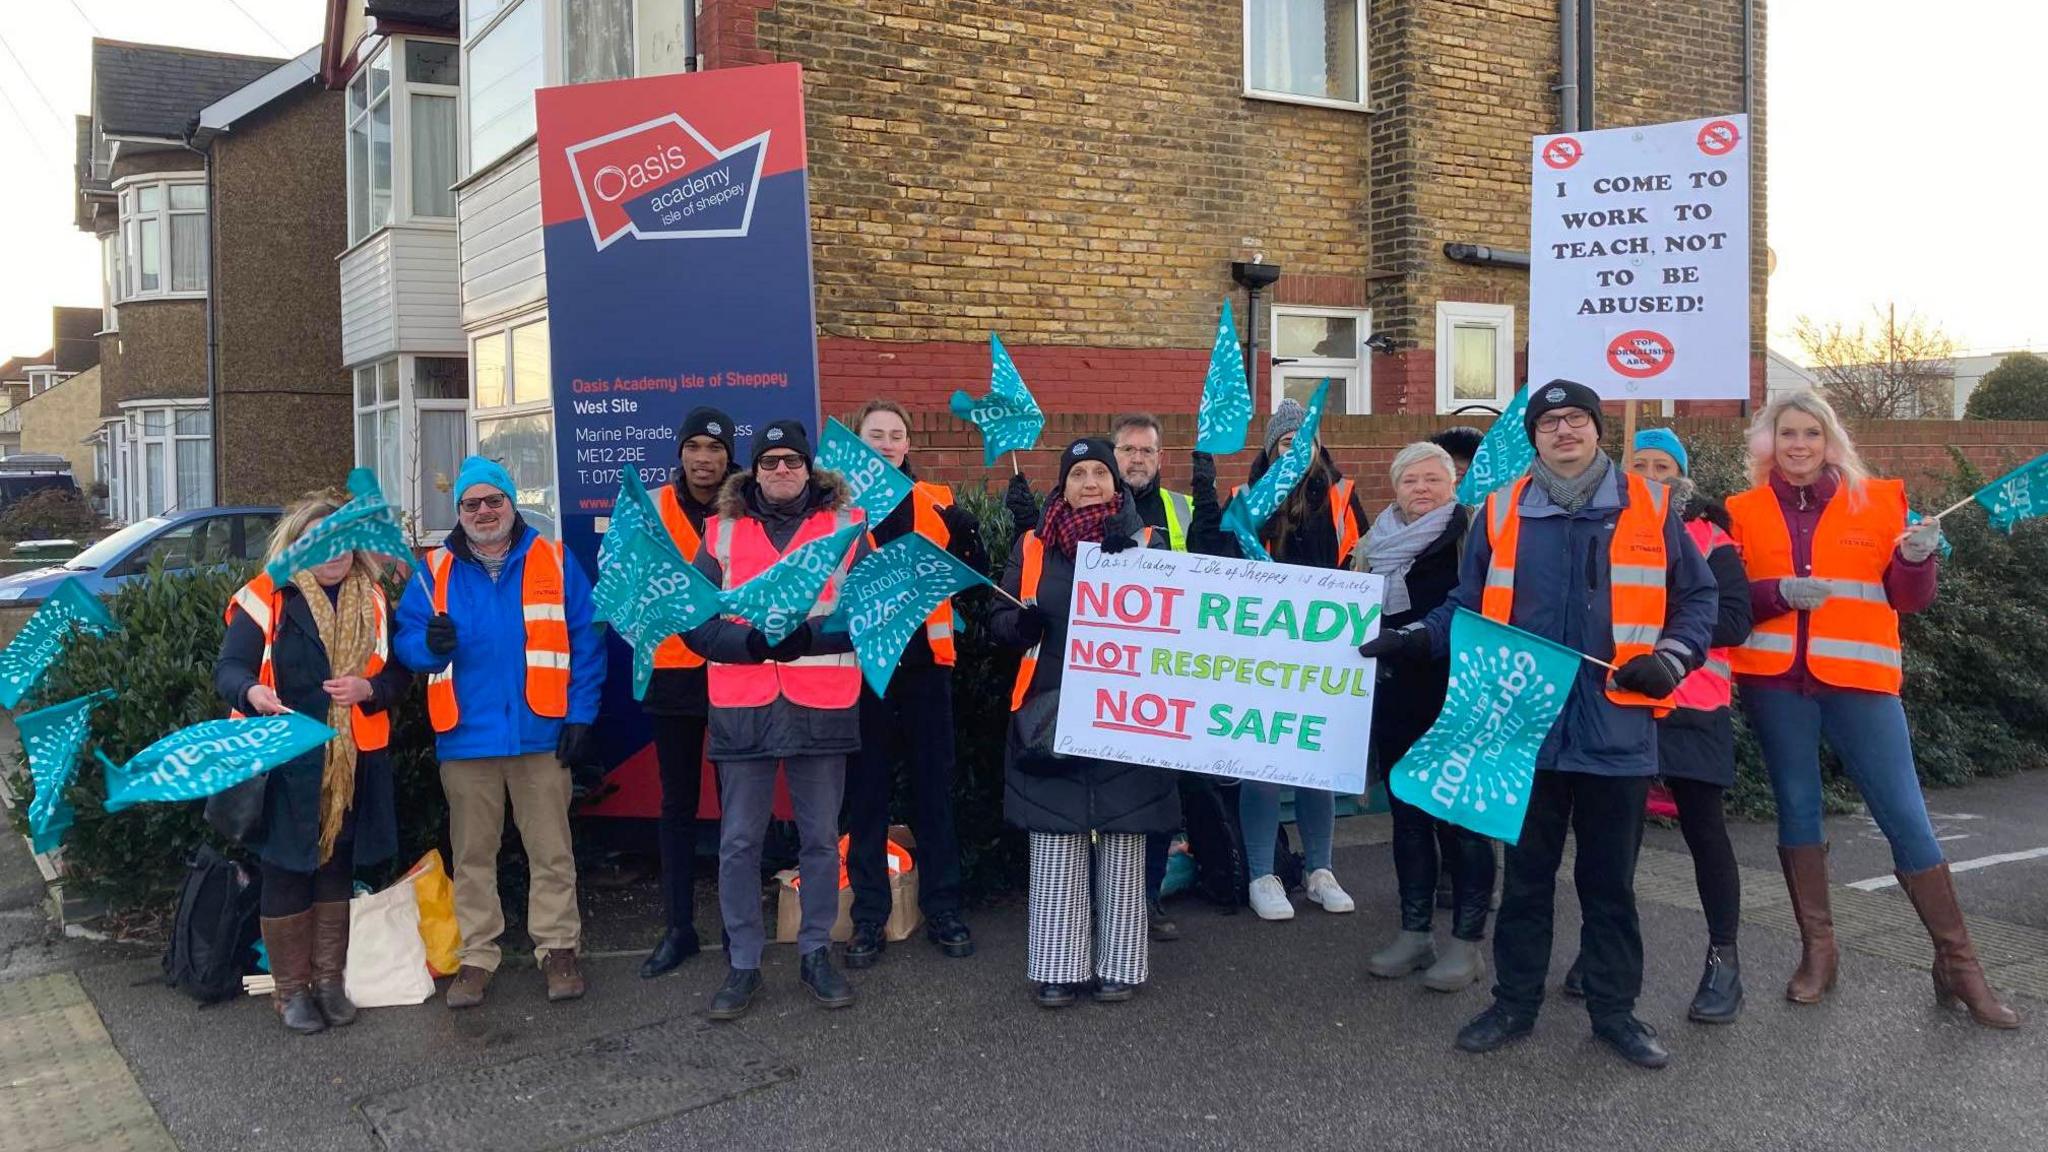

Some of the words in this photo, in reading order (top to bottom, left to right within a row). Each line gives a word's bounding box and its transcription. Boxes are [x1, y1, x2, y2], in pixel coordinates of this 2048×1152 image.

[594, 144, 686, 201] Oasis
[1556, 182, 1567, 198] I
[1593, 174, 1672, 194] COME
[1689, 170, 1728, 189] TO
[651, 166, 730, 212] academy
[661, 207, 681, 226] isle
[683, 201, 697, 217] of
[696, 182, 745, 211] sheppey
[1561, 207, 1648, 230] WORK
[1673, 203, 1713, 221] TO
[1665, 232, 1727, 253] NOT
[1596, 269, 1634, 287] TO
[1662, 266, 1700, 285] BE
[1577, 295, 1704, 315] ABUSED!
[572, 378, 609, 394] Oasis
[614, 375, 677, 392] Academy
[681, 373, 705, 388] Isle
[709, 372, 721, 387] of
[726, 371, 788, 389] Sheppey
[573, 399, 608, 415] West
[611, 398, 638, 413] Site
[576, 426, 622, 442] Marine
[626, 424, 677, 441] Parade,
[577, 449, 613, 463] ME12
[617, 447, 646, 462] 2BE
[578, 470, 590, 484] T:
[592, 469, 625, 484] 0179
[639, 467, 667, 483] 873
[1085, 546, 1129, 571] Oasis
[1133, 552, 1177, 577] Academy
[1225, 565, 1239, 581] of
[1239, 559, 1288, 584] Sheppey
[1076, 580, 1184, 627] NOT
[1197, 592, 1382, 647] READY
[1070, 638, 1142, 671] NOT
[1095, 688, 1196, 733] NOT
